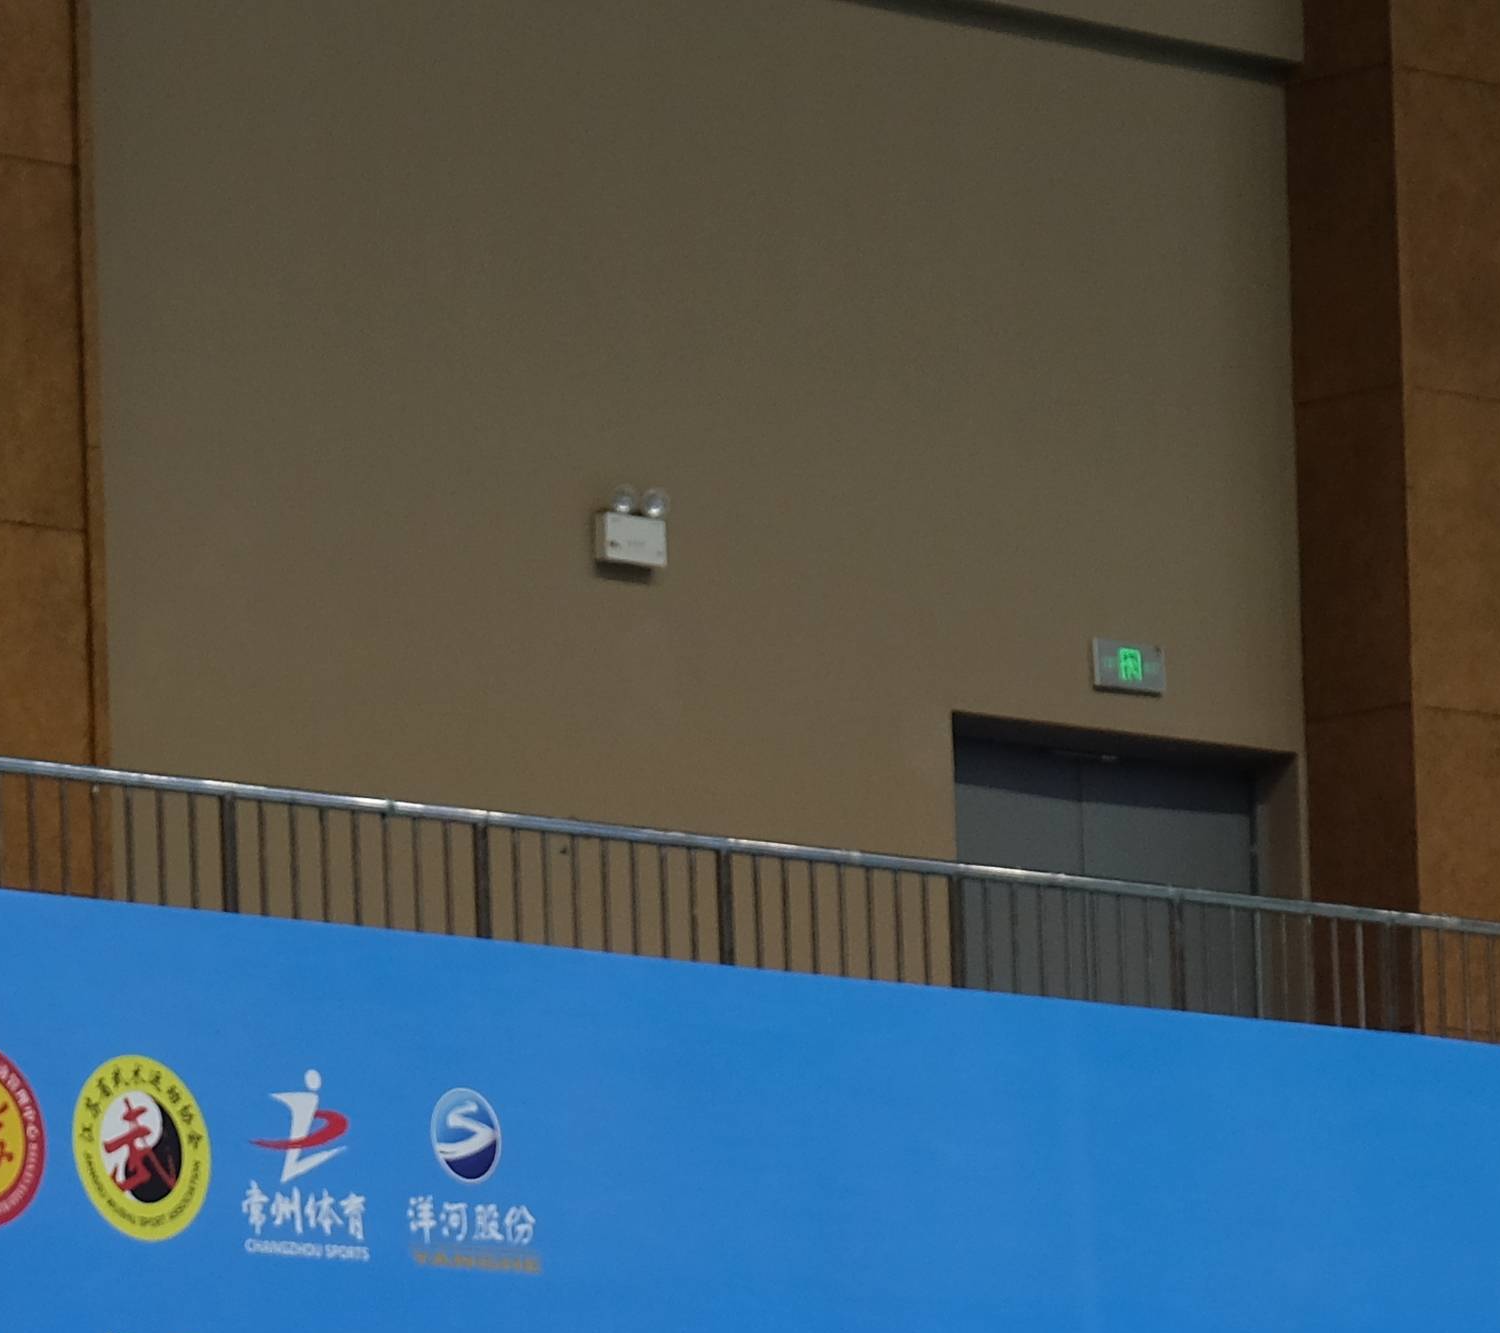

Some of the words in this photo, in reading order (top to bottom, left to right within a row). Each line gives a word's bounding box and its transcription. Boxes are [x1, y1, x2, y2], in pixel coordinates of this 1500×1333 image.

[242, 1179, 367, 1241] 常州体育
[407, 1195, 536, 1245] 洋河股份
[244, 1238, 323, 1259] CHANGZHOU
[325, 1244, 370, 1262] SPORTS
